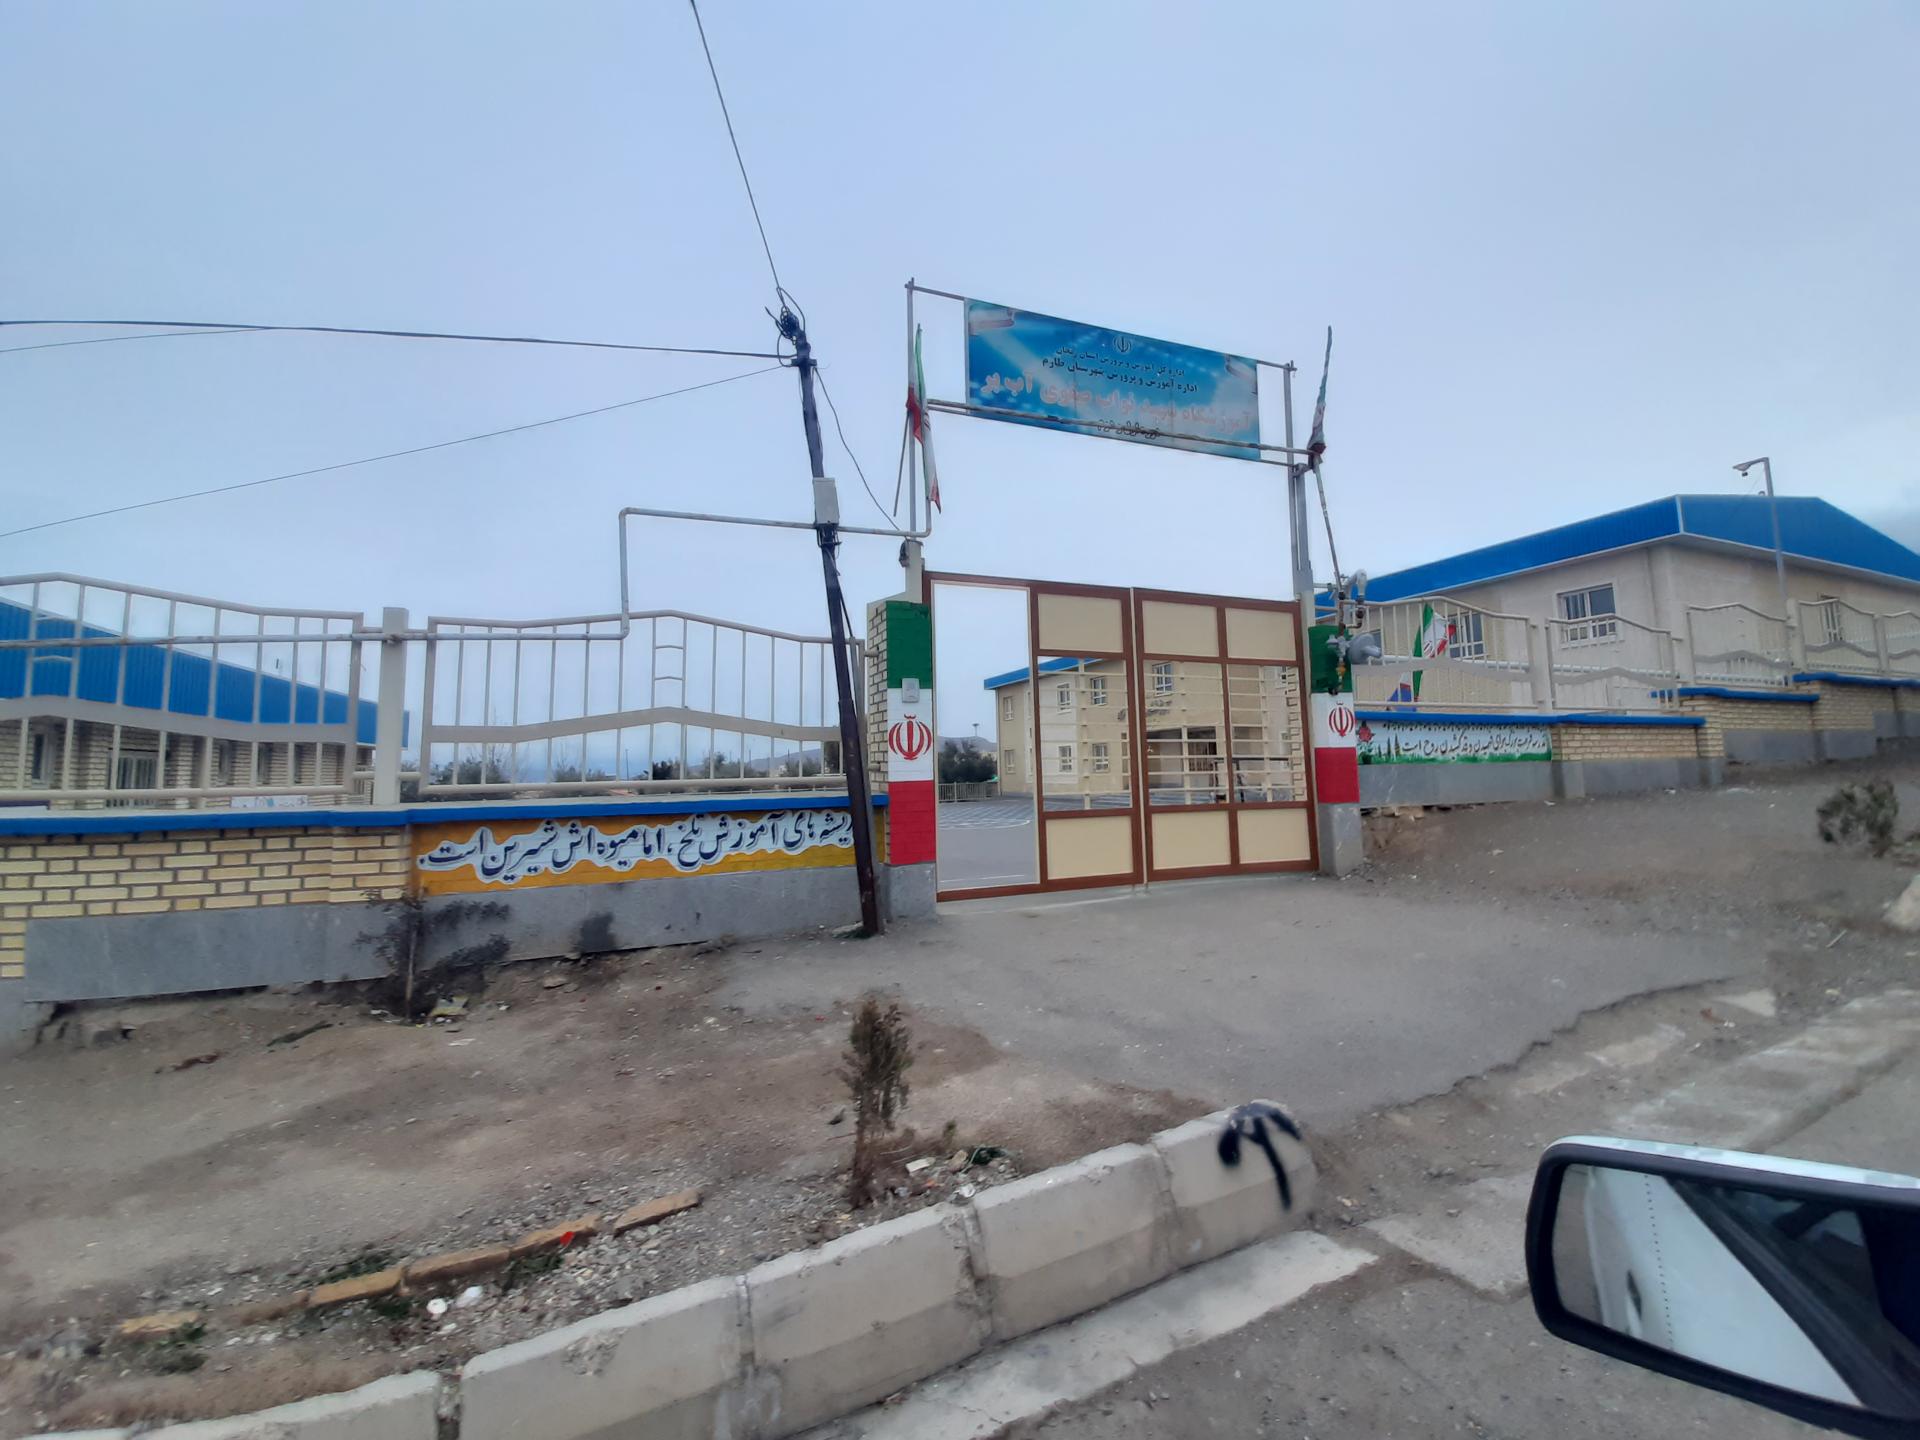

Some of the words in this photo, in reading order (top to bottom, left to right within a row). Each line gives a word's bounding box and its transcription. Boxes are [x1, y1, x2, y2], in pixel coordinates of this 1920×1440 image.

[1042, 357, 1065, 369] طارم
[1067, 361, 1104, 377] شهرستان
[1107, 371, 1136, 385] پرورش
[1145, 375, 1175, 390] آموزش
[1177, 383, 1198, 394] اداره
[1402, 739, 1422, 752] است
[1424, 739, 1439, 756] روح
[699, 813, 785, 861] آموزش
[784, 812, 815, 848] های
[481, 820, 560, 881] شیرین
[552, 822, 593, 869] اش
[597, 829, 639, 867] میوه
[643, 828, 666, 856] اما
